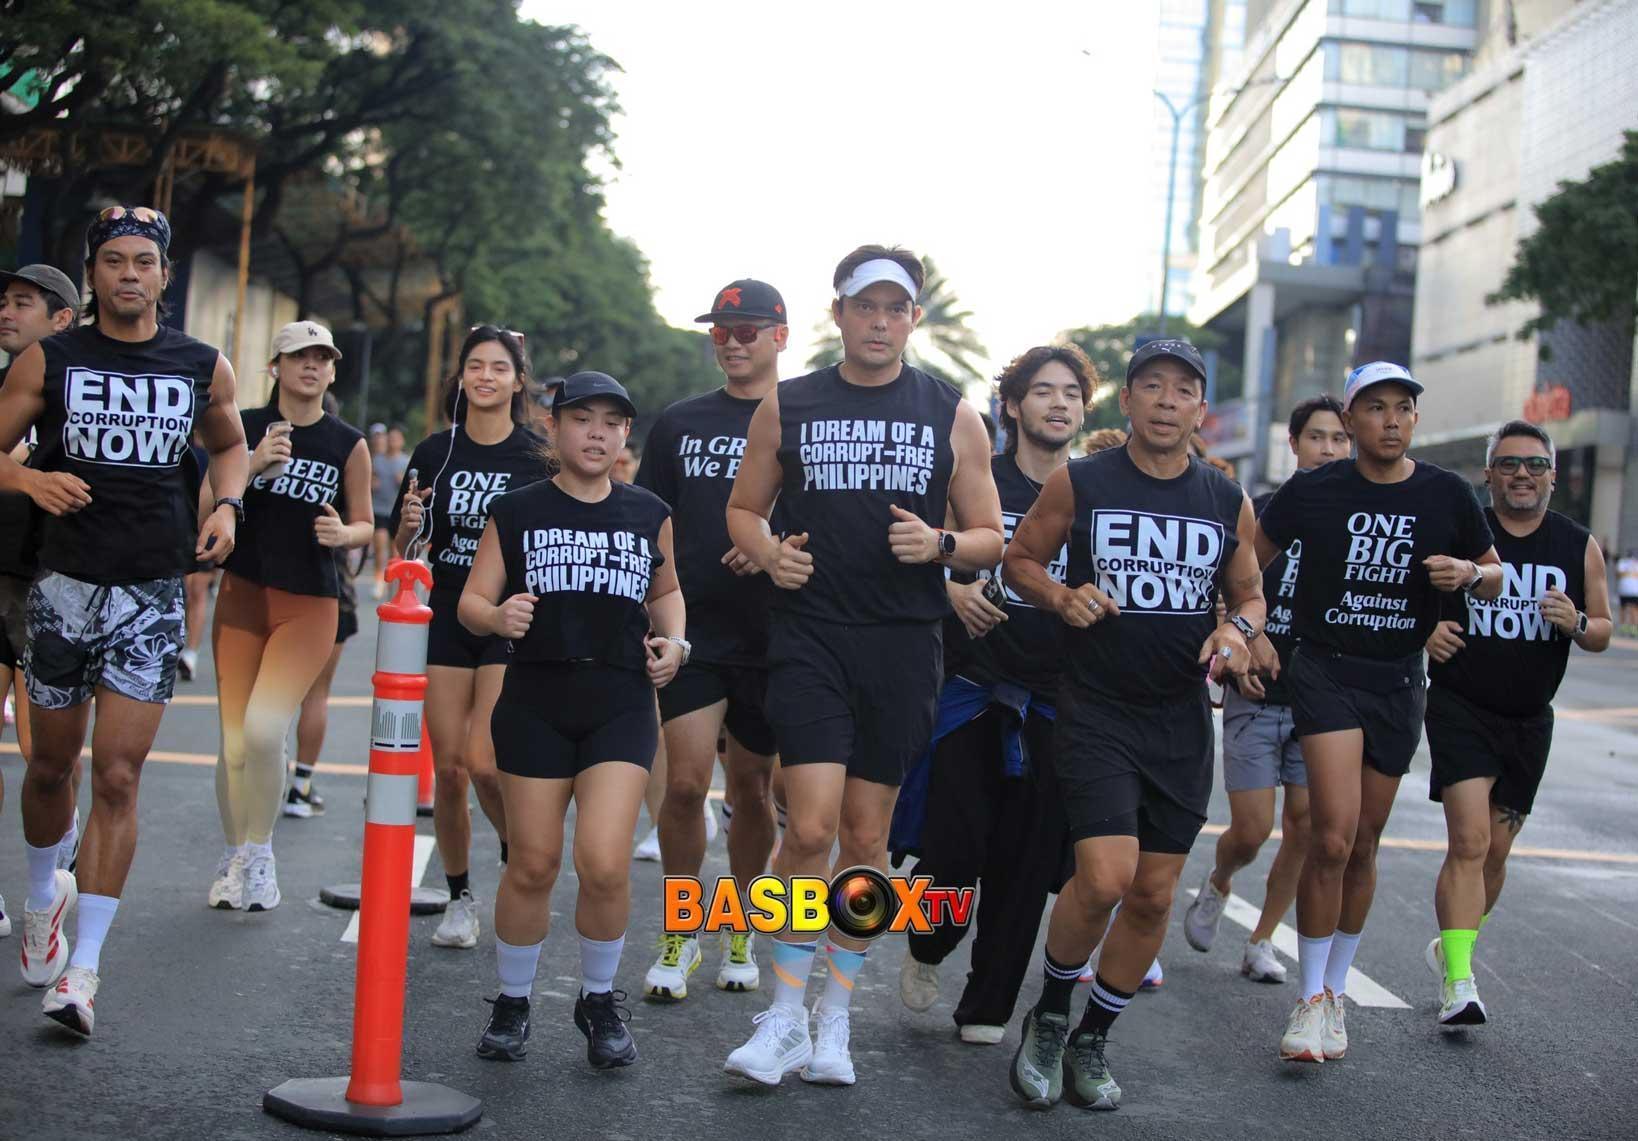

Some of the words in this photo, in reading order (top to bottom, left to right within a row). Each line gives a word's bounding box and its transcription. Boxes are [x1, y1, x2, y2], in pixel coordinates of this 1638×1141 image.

[69, 371, 191, 416] END
[70, 412, 189, 433] CORRUPTION
[800, 423, 808, 444] I
[811, 420, 886, 442] DREAM
[891, 421, 916, 444] OF
[920, 425, 935, 448] A
[67, 427, 187, 464] NOW!
[679, 435, 703, 456] In
[800, 442, 934, 469] CORRUPT-FREE
[283, 457, 340, 490] REED,
[449, 470, 511, 491] ONE
[683, 456, 720, 478] We
[803, 463, 932, 495] PHILIPPINES
[1347, 512, 1416, 538] ONE
[523, 530, 529, 553] I
[533, 528, 609, 549] DREAM
[613, 531, 635, 552] OF
[1096, 514, 1220, 566] END
[1345, 535, 1414, 568] BIG
[525, 545, 652, 579] CORRUPT-FREE
[1344, 564, 1411, 585] FIGHT
[525, 565, 649, 604] PHILIPPINES
[1501, 562, 1567, 600] ND
[1340, 591, 1408, 611] Against
[1466, 596, 1542, 611] CORRUPT
[1324, 608, 1417, 631] Corruption
